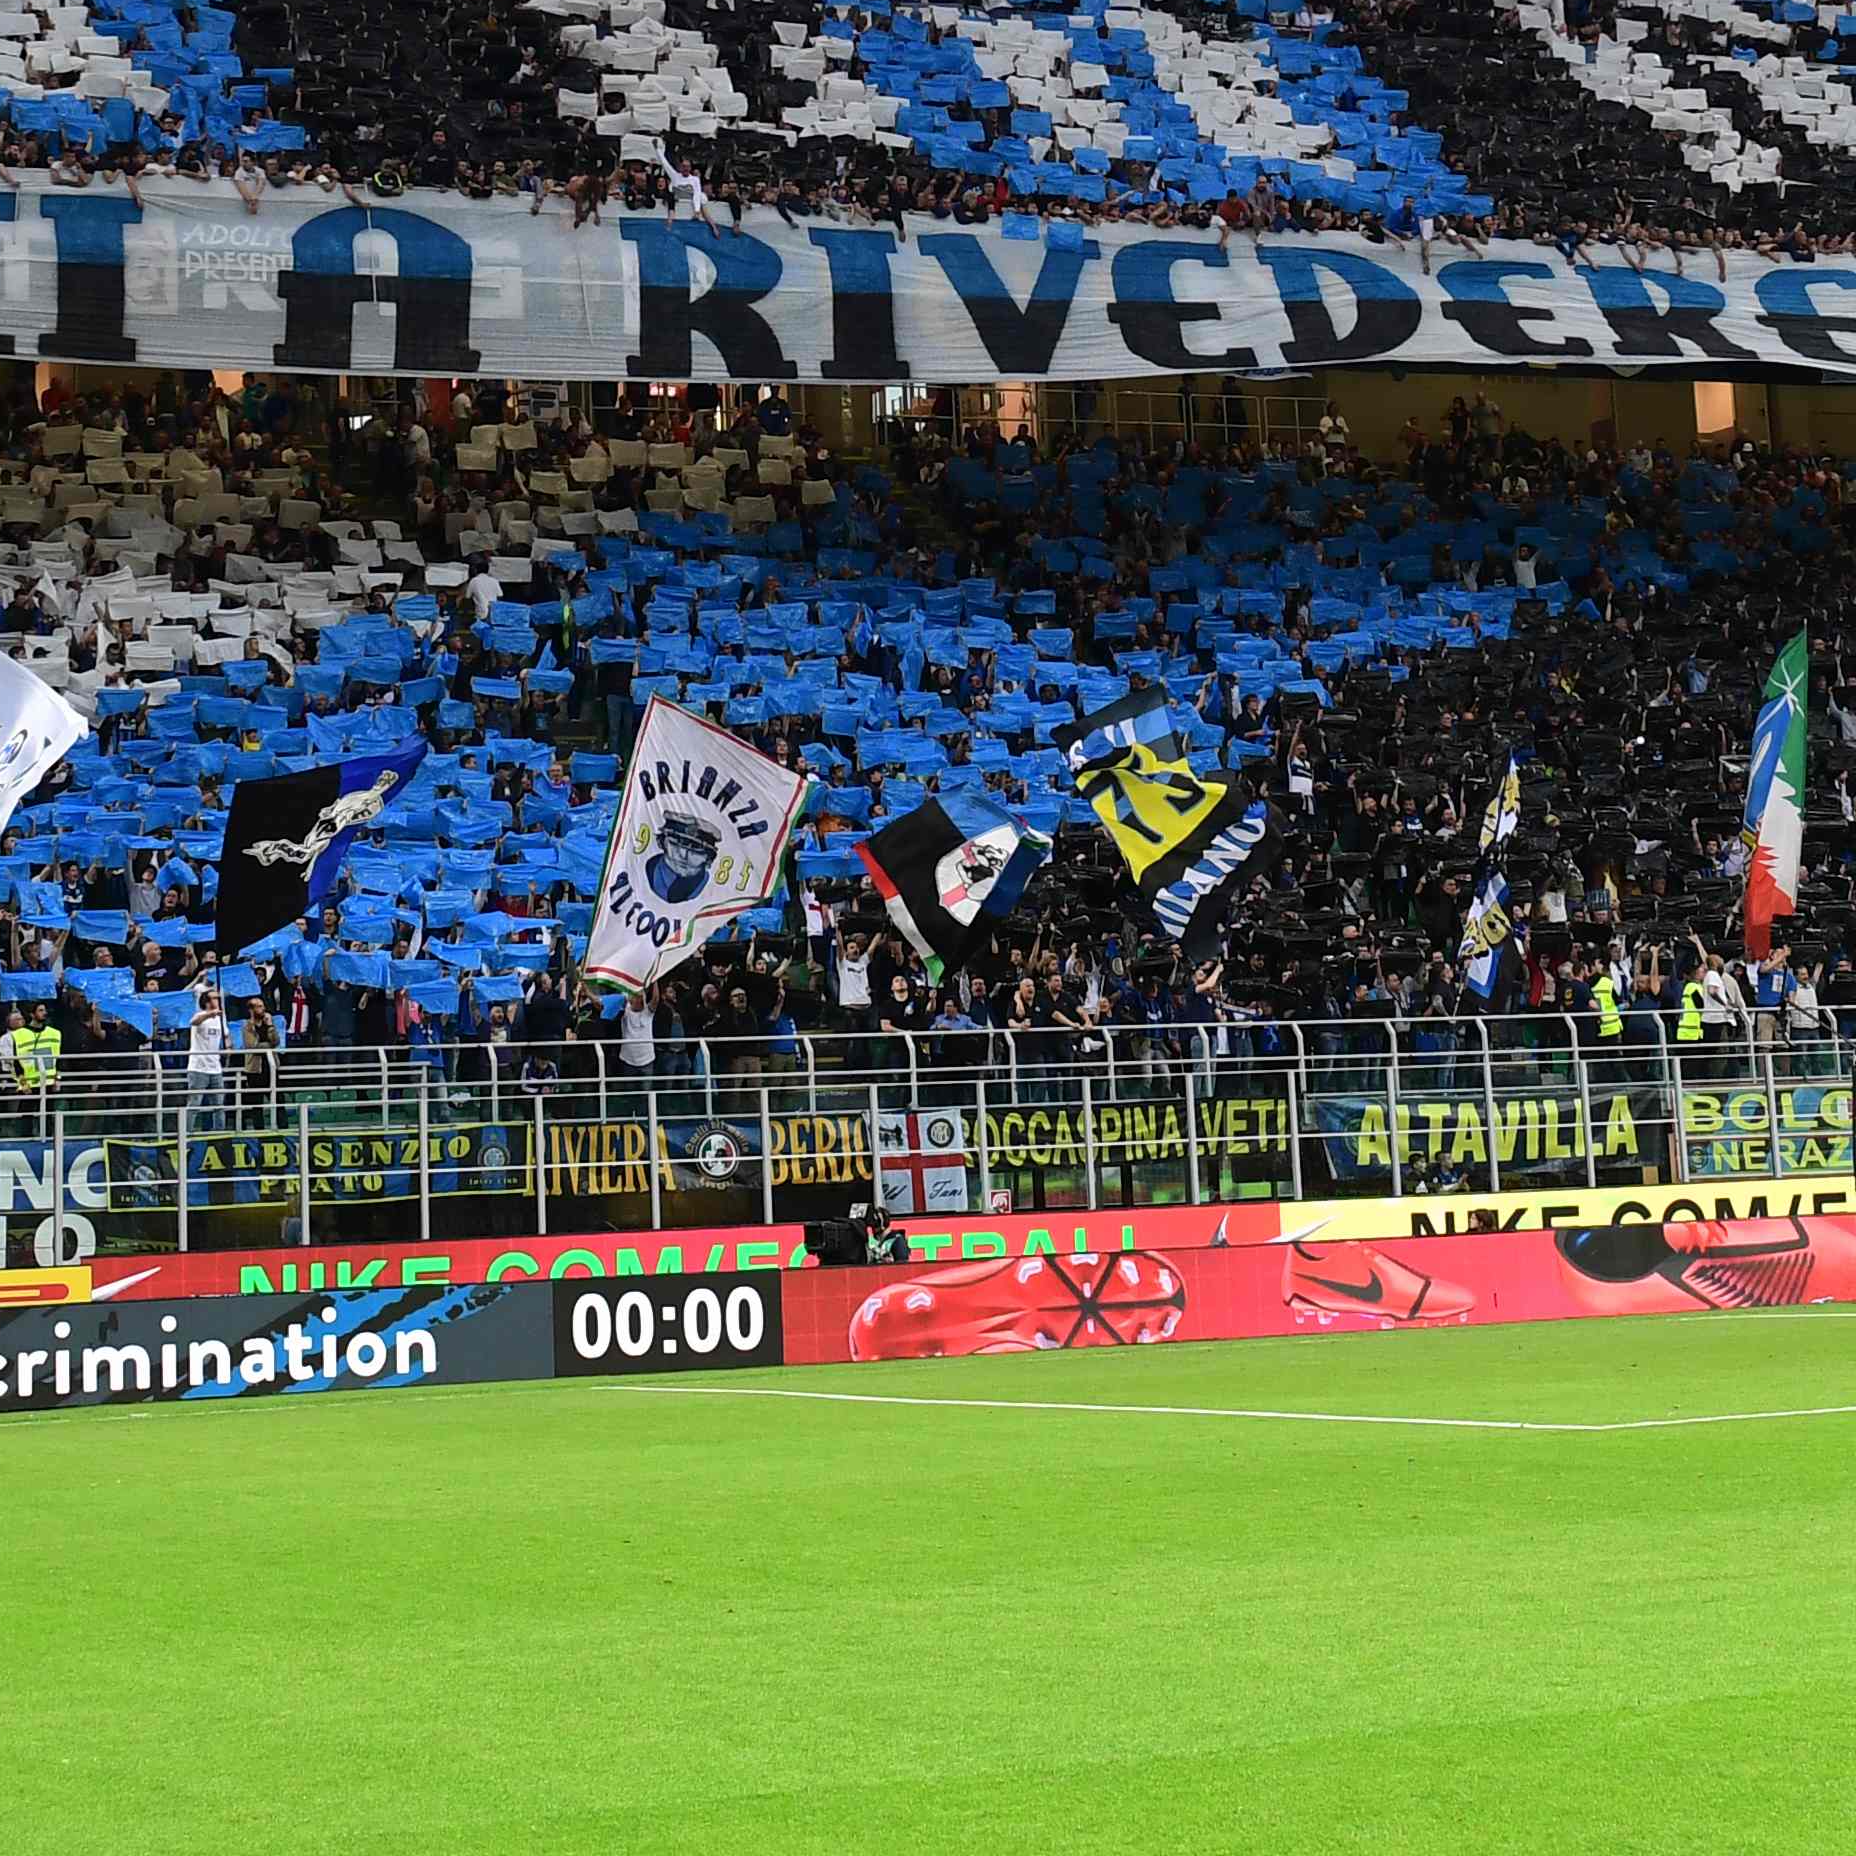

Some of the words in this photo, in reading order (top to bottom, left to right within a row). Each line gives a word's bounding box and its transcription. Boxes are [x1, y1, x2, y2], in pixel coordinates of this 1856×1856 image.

[274, 207, 482, 373] A
[638, 759, 769, 840] BRIANZA
[166, 1134, 471, 1173] VALBSENZIO
[259, 1173, 383, 1197] PRATO
[572, 1286, 765, 1360] 00:00
